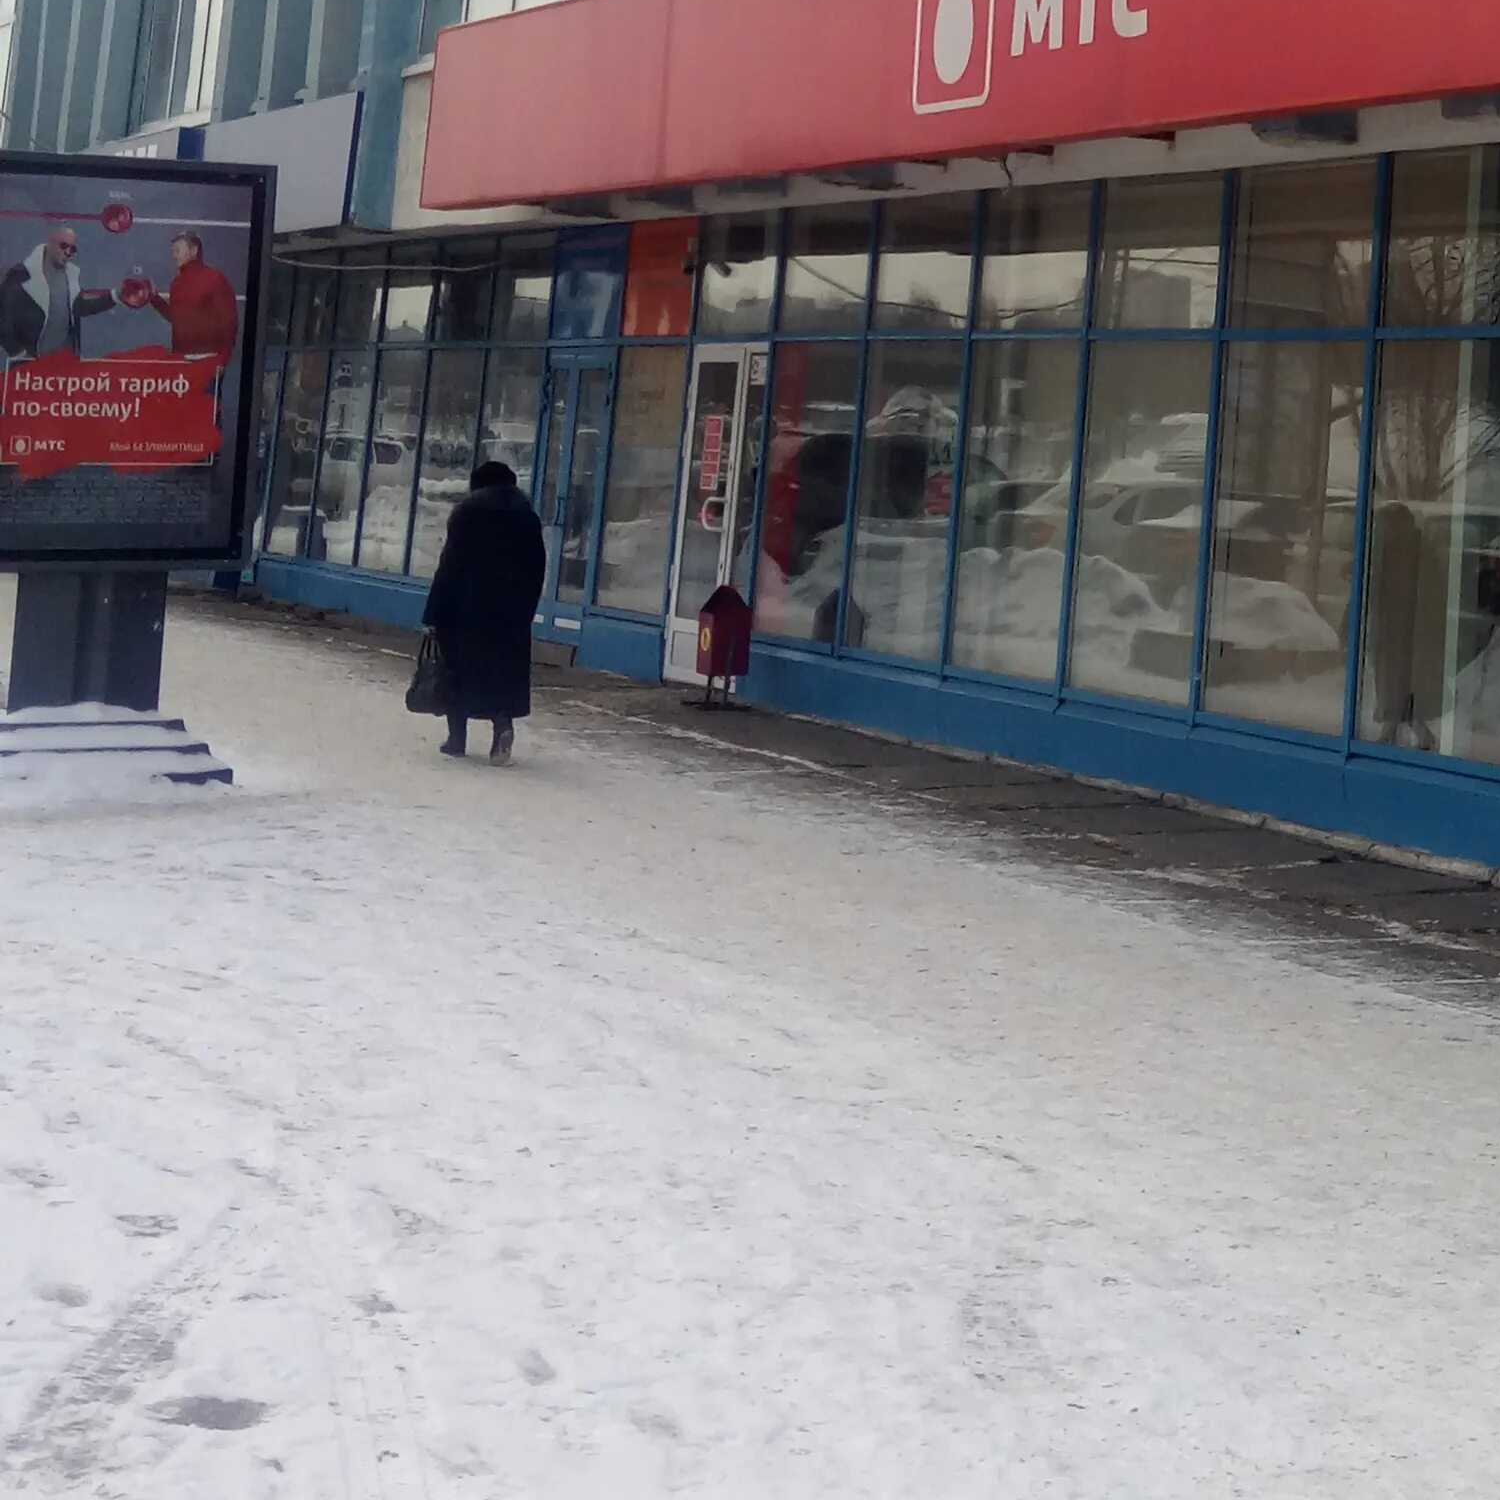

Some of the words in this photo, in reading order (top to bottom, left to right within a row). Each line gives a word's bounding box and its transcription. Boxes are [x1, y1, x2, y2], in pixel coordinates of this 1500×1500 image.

[15, 371, 110, 397] Настрой
[118, 373, 190, 398] тариф
[12, 397, 140, 422] по-своему!
[34, 439, 65, 451] МТС
